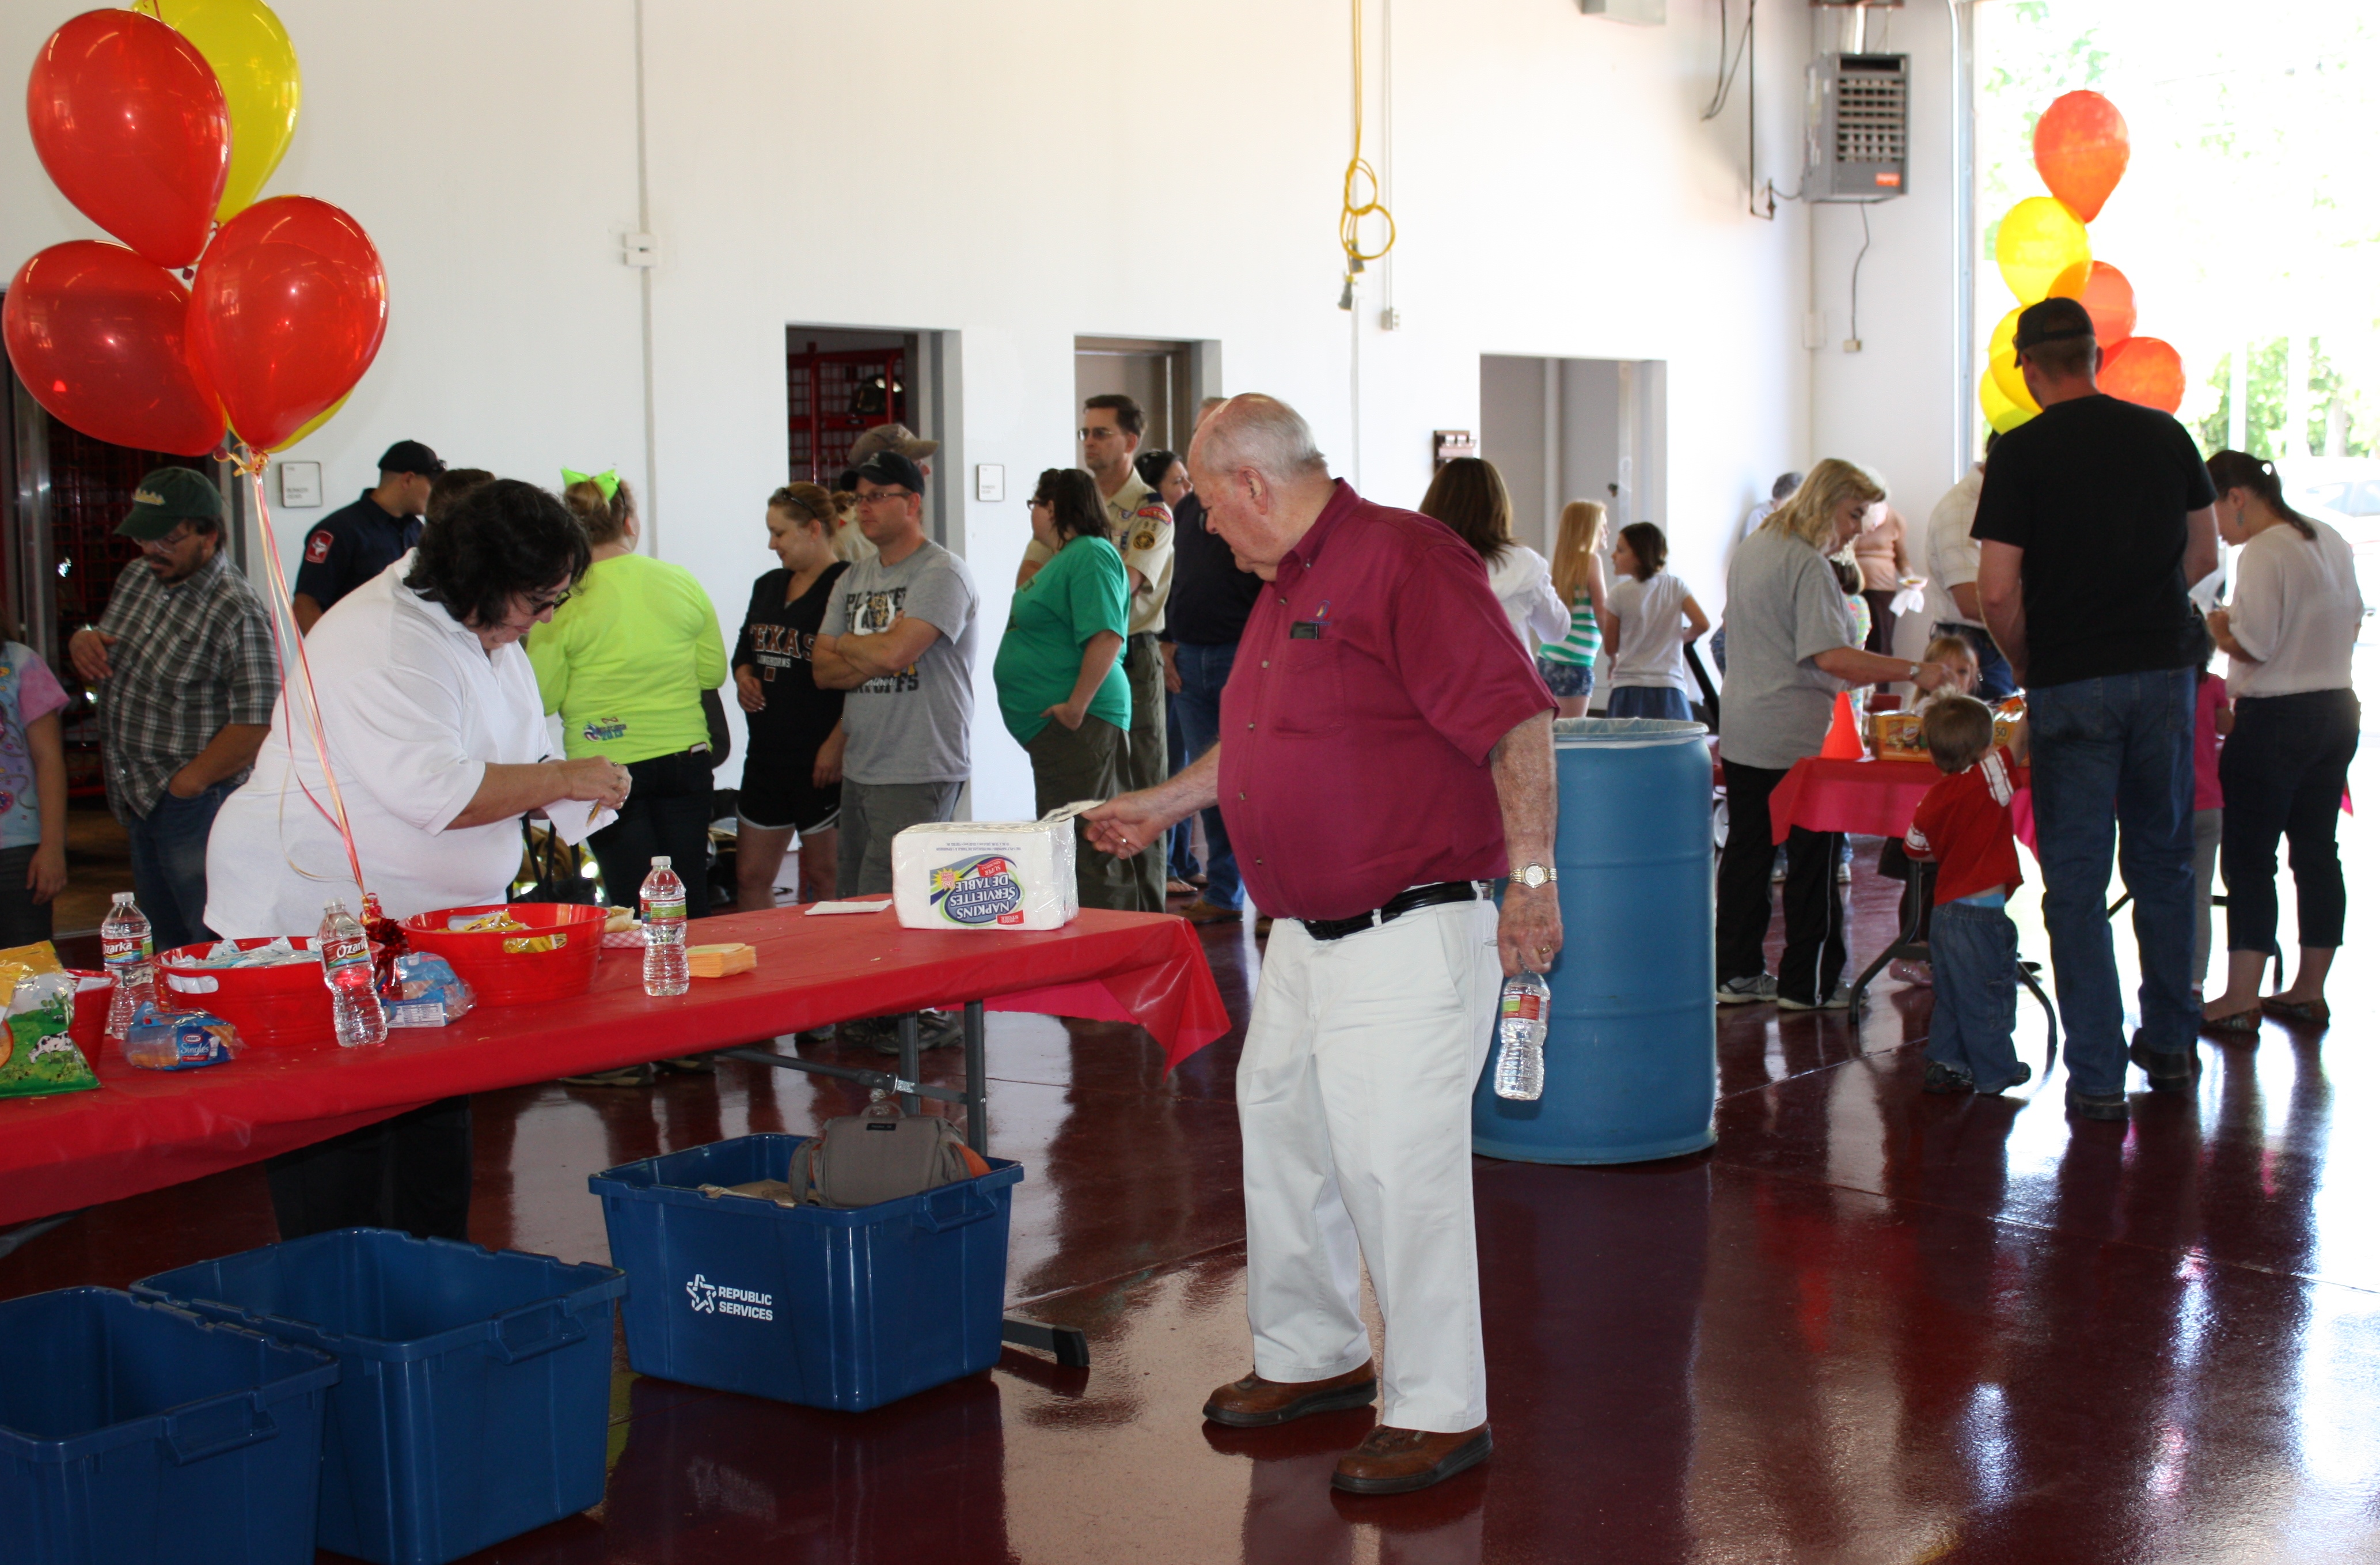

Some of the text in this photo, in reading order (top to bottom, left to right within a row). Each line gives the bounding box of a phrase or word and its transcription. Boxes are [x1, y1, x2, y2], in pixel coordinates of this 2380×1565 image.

[1995, 727, 2007, 737] 50
[985, 865, 1001, 876] SUPER
[955, 874, 1008, 892] DE TABLE
[950, 886, 1016, 907] SERVIETTES
[956, 901, 1010, 919] NAPKINS
[181, 1043, 210, 1056] Singles
[718, 1286, 772, 1306] REPUBLIC
[719, 1301, 773, 1321] SERVICES
